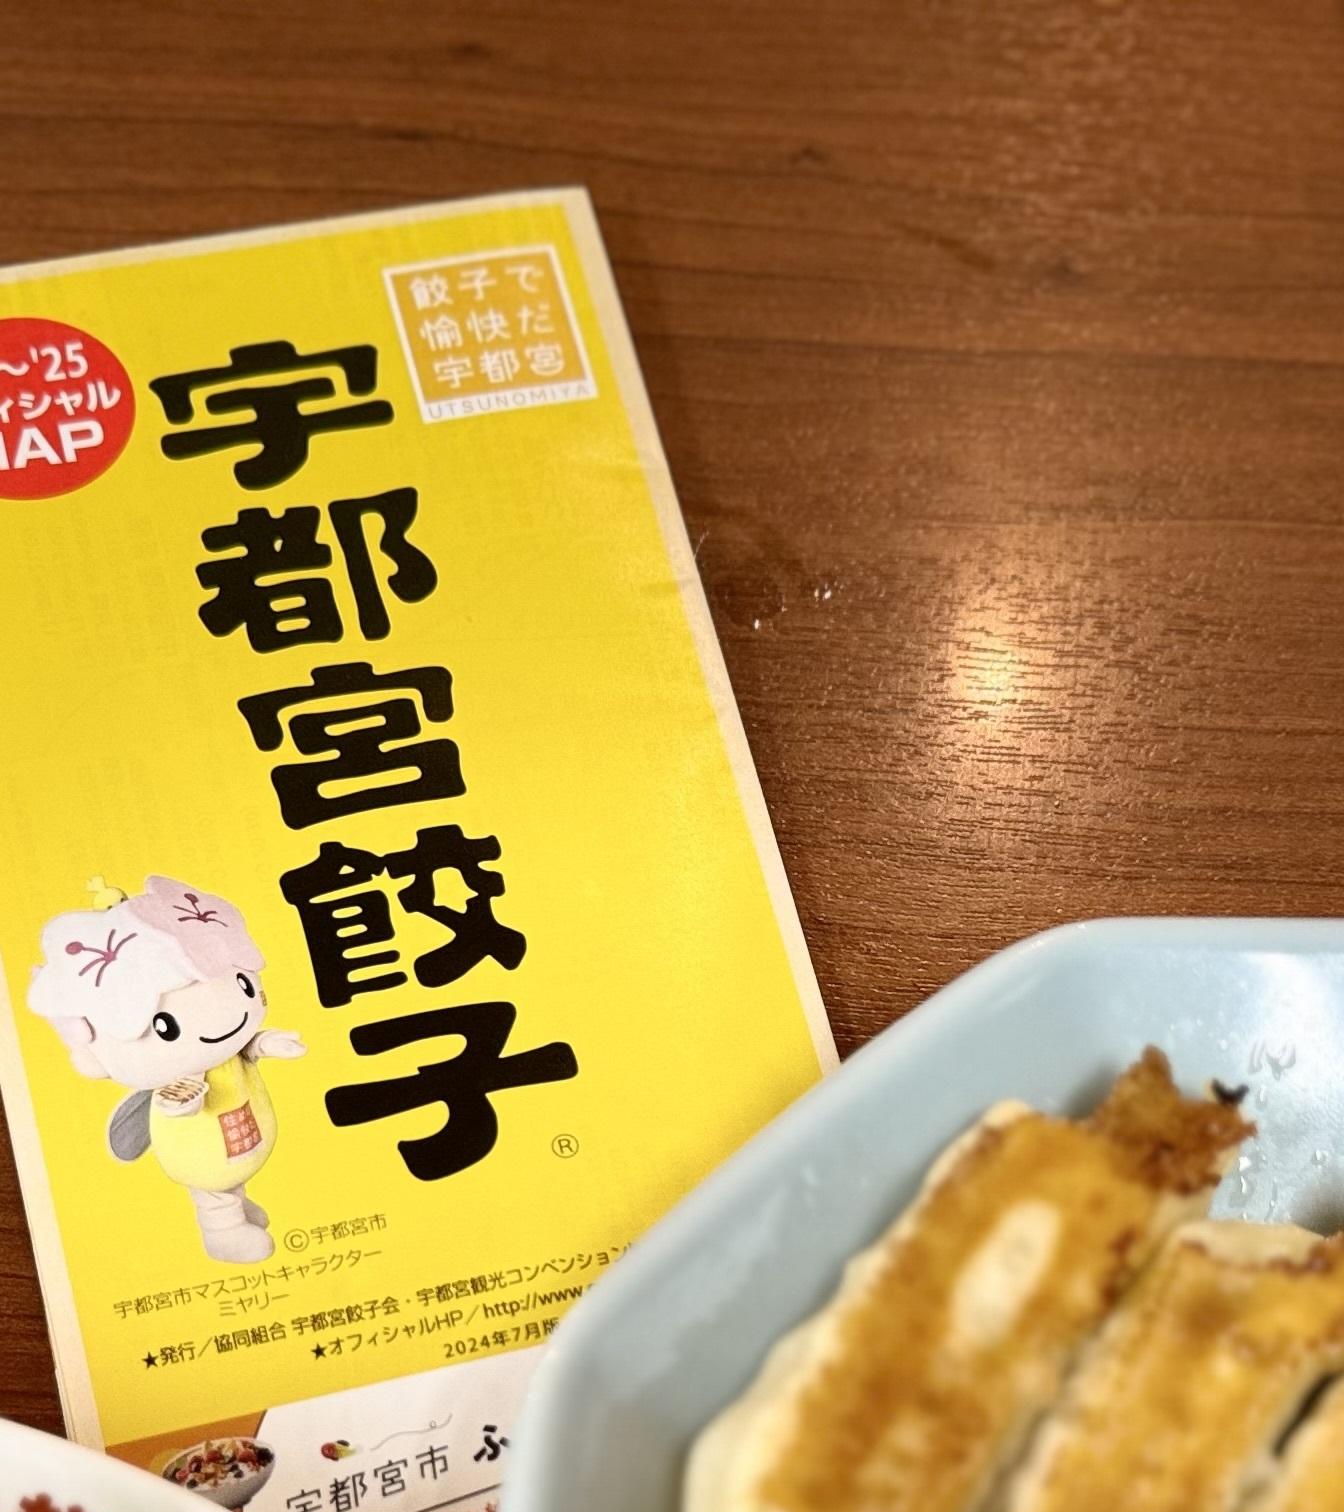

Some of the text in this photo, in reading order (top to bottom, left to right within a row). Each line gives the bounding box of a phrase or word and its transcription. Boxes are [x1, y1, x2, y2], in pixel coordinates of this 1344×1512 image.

[409, 264, 545, 311] 餃子で
[419, 303, 555, 352] 愉快だ
[433, 343, 566, 389] 宇都宮
[427, 384, 590, 420] UTSUNOMIYA
[149, 340, 578, 1182] 宇都宮餃子
[112, 1249, 383, 1320] 宇都宮市マスコットキャラクター
[218, 1291, 290, 1317] ミヤリー
[291, 1241, 632, 1337] 宇都宮餃子会・宇都宮観光コンベンション
